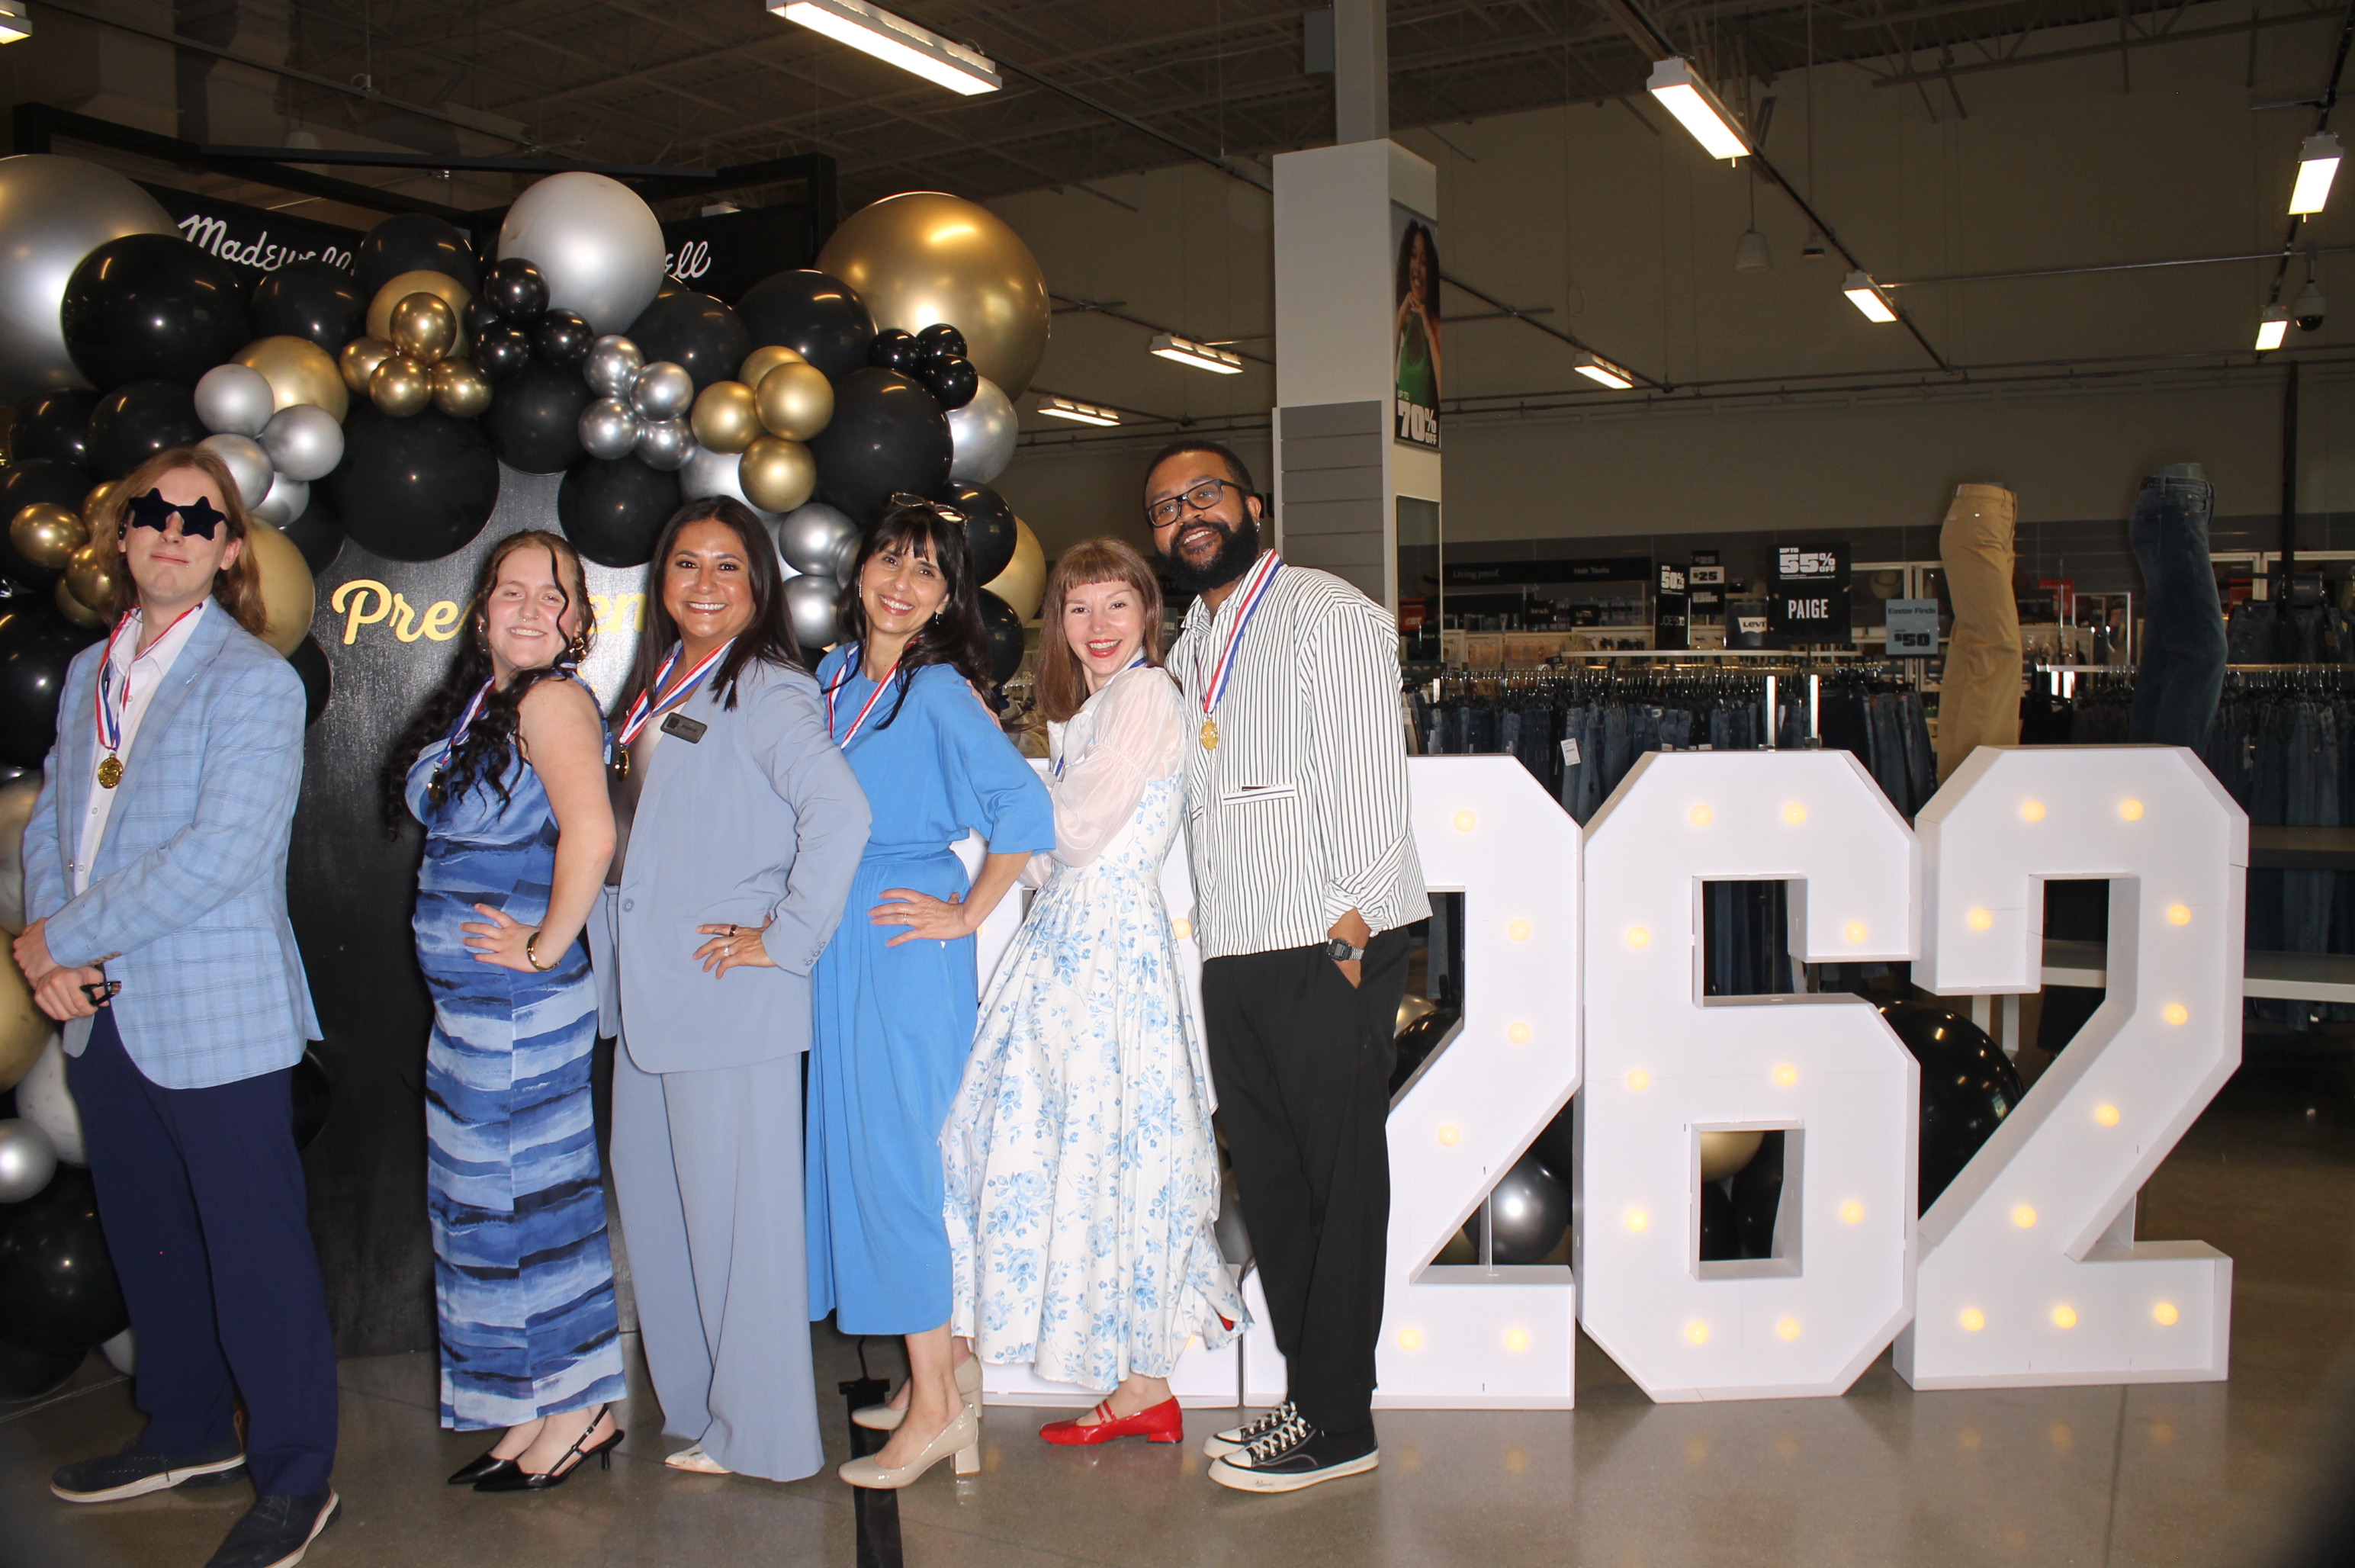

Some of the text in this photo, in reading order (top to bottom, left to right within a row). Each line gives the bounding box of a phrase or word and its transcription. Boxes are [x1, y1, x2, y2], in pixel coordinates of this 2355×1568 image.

[178, 214, 354, 276] Madew
[1398, 399, 1437, 442] 70%
[1425, 432, 1437, 445] OFF
[1779, 552, 1835, 574] 55%
[1454, 570, 1476, 579] Living
[1693, 571, 1717, 580] $25
[1788, 599, 1829, 619] PAIGE
[1914, 606, 1936, 615] Finds
[1894, 633, 1930, 647] $50
